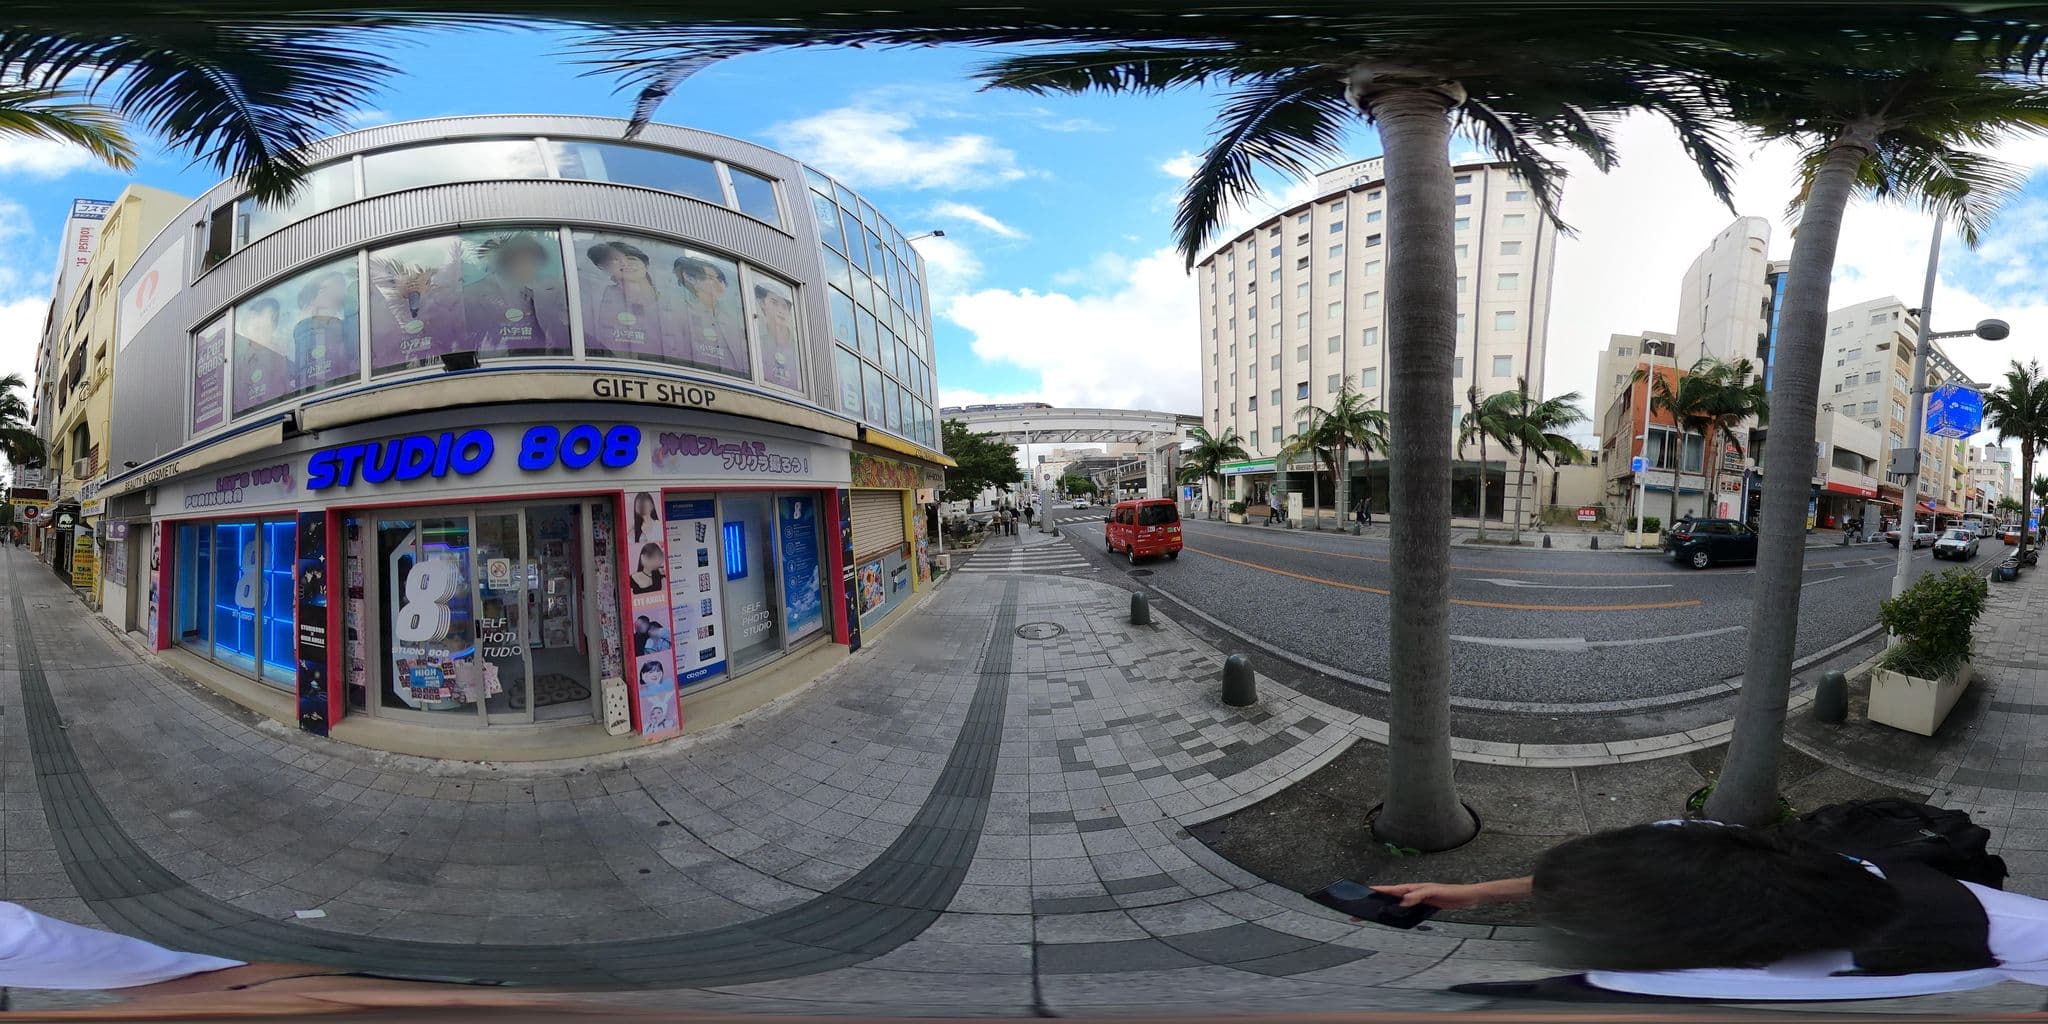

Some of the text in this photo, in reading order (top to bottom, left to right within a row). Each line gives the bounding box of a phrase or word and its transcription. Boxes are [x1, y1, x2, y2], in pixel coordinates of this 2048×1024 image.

[499, 326, 533, 336] 小宇宙
[592, 378, 716, 406] GIFT SHOP
[306, 424, 642, 490] STUDIO 808
[124, 477, 143, 491] BEAUTY
[147, 461, 180, 483] COSMETIC
[185, 487, 243, 509] PURIKURA
[793, 501, 802, 520] 8
[396, 560, 458, 642] 8
[741, 601, 761, 615] SELF
[481, 617, 507, 628] ELF
[742, 610, 770, 626] PHOTO
[743, 620, 772, 638] STUDIO
[392, 647, 426, 656] STUDIO
[415, 668, 437, 677] HIGH
